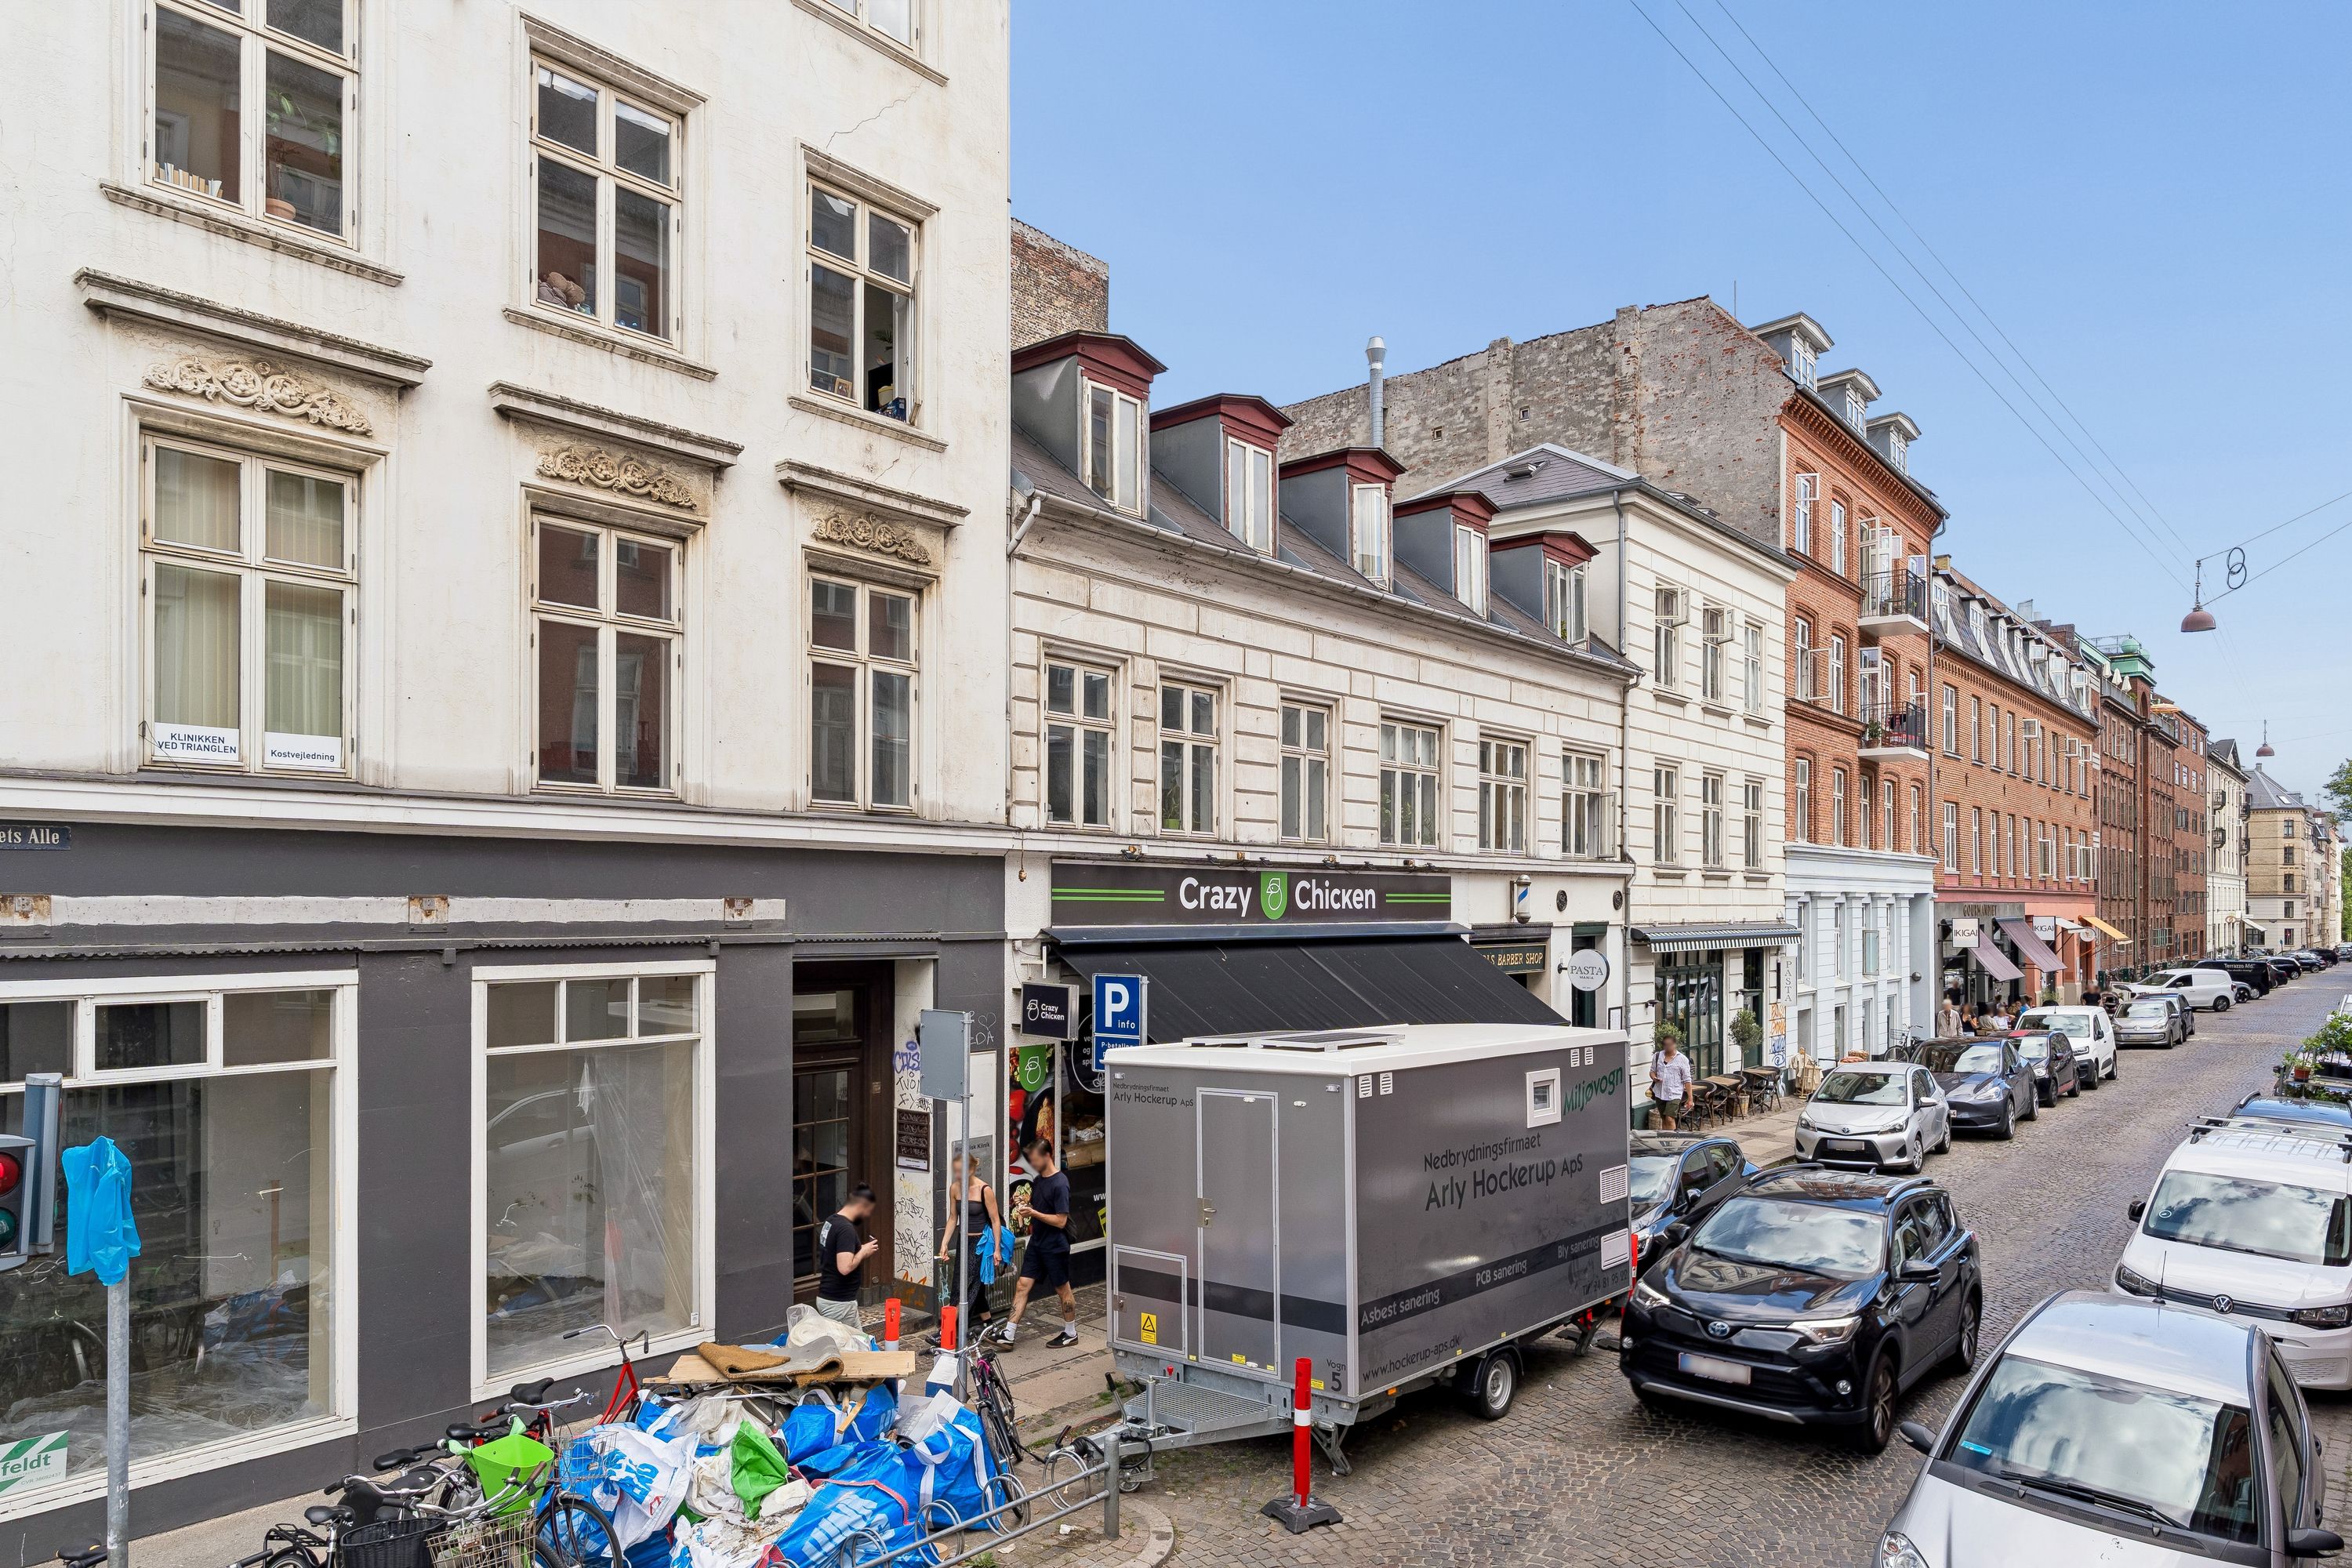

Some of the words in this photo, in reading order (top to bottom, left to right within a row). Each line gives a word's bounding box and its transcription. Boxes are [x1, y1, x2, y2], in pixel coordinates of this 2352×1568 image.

[170, 732, 225, 744] KLINIKKEN
[158, 740, 178, 750] VED
[180, 742, 237, 753] TRIANGLEN
[270, 750, 336, 762] Kostvejledning
[27, 828, 60, 844] Alle
[1179, 877, 1252, 917] Crazy
[1295, 879, 1376, 910] Chicken
[1954, 928, 1978, 937] IKIGAI
[1497, 953, 1524, 966] BARBER
[1526, 952, 1544, 964] SHOP
[1570, 965, 1604, 976] PASTA
[1040, 1003, 1058, 1012] Crazy
[1105, 982, 1130, 1028] P
[1040, 1011, 1065, 1020] Chicken
[1118, 1019, 1136, 1029] info
[1112, 1083, 1169, 1092] Nedbrydningsfirmaet
[1563, 1066, 1623, 1116] Miljøvogn
[1113, 1091, 1131, 1104] Arly
[1134, 1093, 1178, 1107] Hockerup
[1180, 1098, 1194, 1108] ApS
[1424, 1132, 1541, 1173] Nedbrydningsfirmaet
[1425, 1176, 1467, 1211] Arly
[1473, 1158, 1555, 1199] Hockerup
[1561, 1152, 1583, 1178] ApS
[1558, 1244, 1569, 1259] Bly
[1570, 1235, 1599, 1254] sanering
[1475, 1270, 1491, 1287] PCB
[1494, 1259, 1527, 1282] sanering
[1360, 1304, 1397, 1327] Asbest
[1399, 1287, 1440, 1312] sanering
[1326, 1358, 1346, 1371] Vogn
[1362, 1334, 1461, 1382] www.hockerup-aps.dk
[1330, 1372, 1342, 1392] 5
